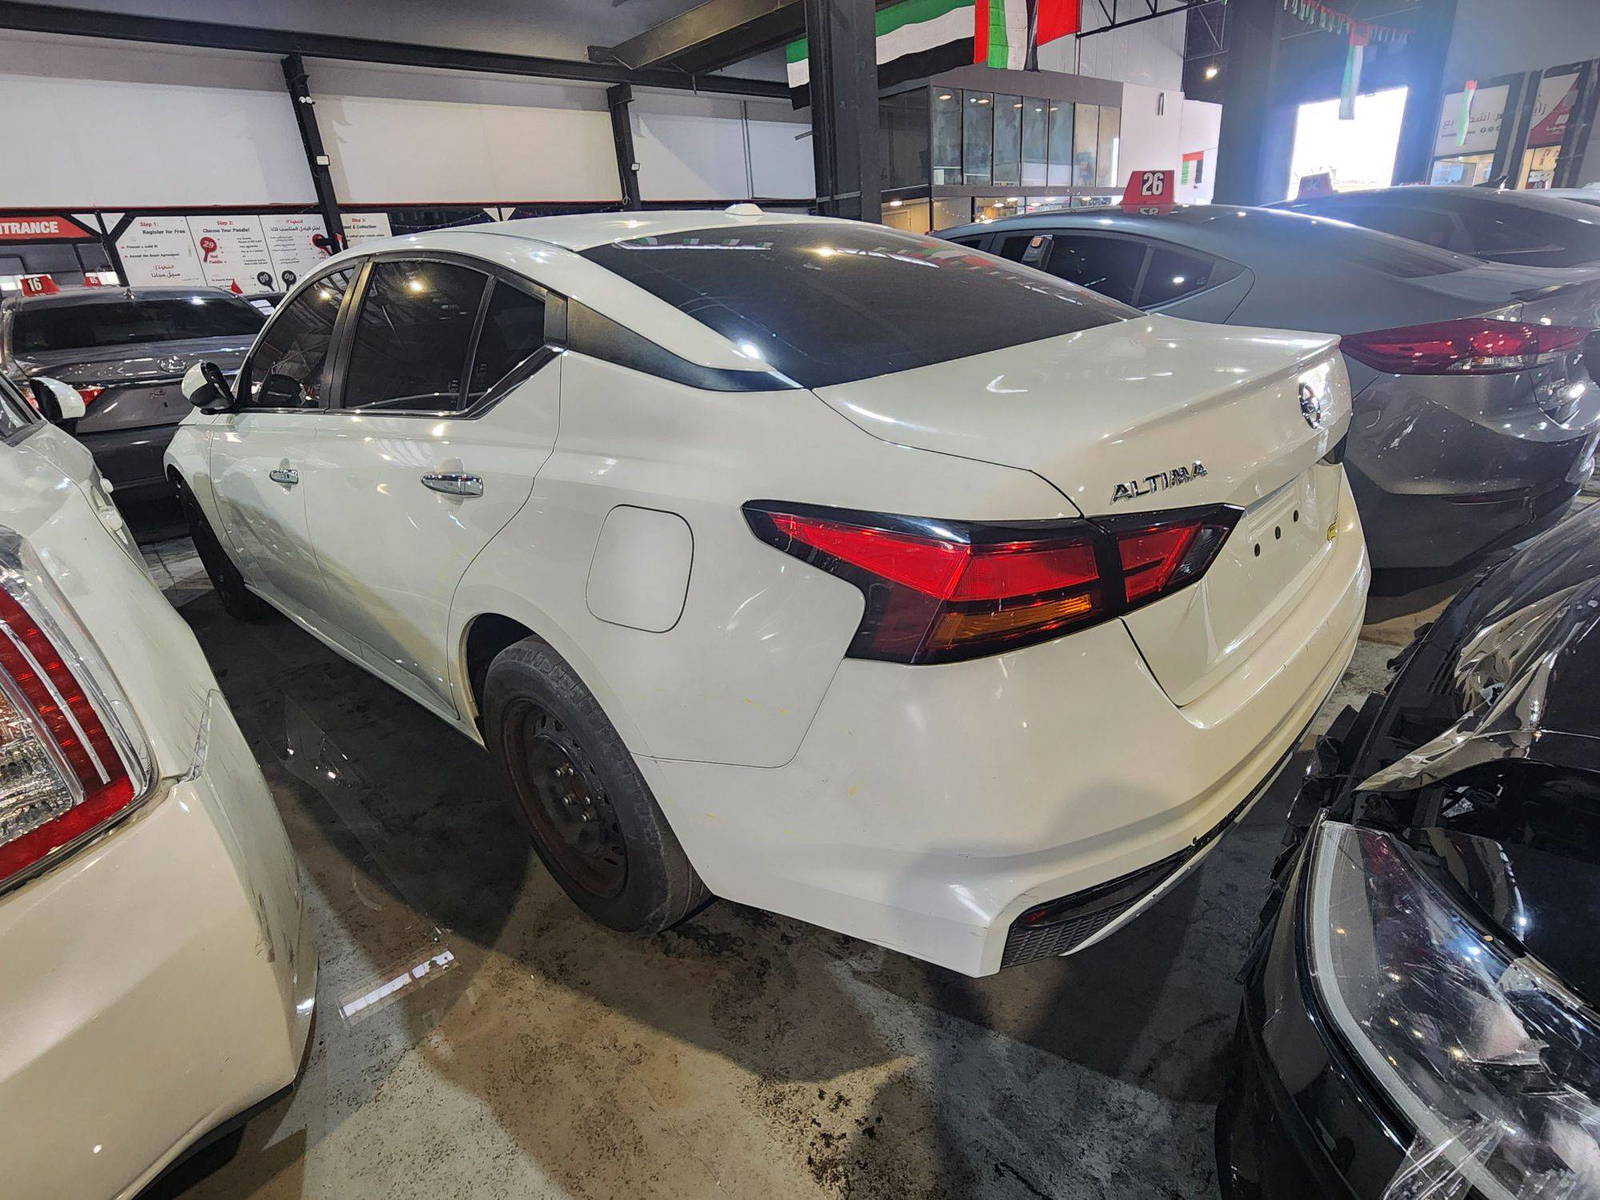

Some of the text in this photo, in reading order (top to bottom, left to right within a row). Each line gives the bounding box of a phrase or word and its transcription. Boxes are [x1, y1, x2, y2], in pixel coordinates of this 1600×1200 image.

[1142, 172, 1164, 196] 26
[28, 277, 42, 292] 16
[1109, 460, 1208, 505] ALTIMA
